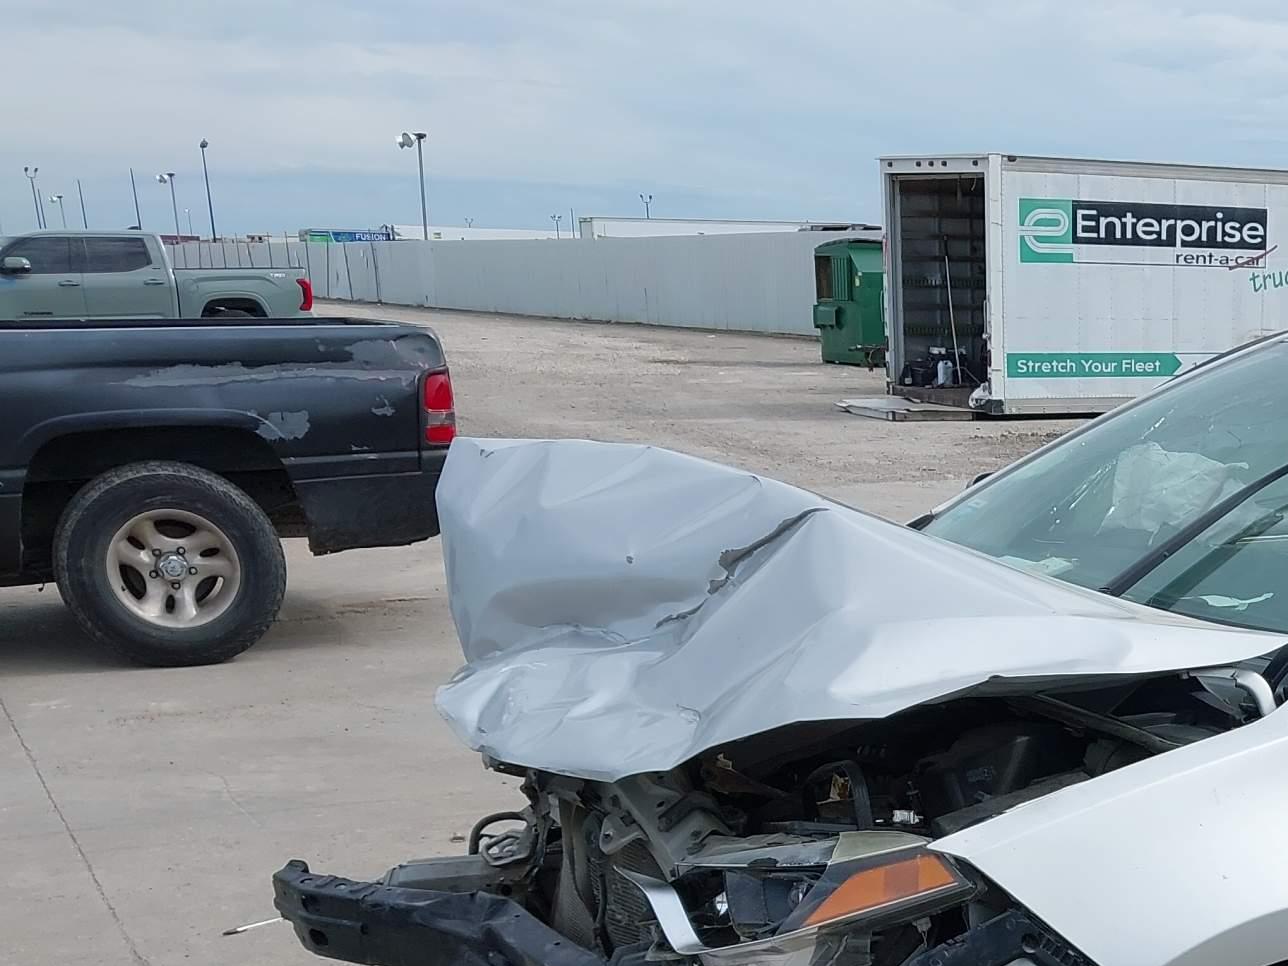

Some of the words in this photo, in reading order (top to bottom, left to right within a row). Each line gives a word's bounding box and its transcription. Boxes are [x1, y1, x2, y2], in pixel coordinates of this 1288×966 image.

[1076, 209, 1265, 249] Enterprise
[1175, 252, 1264, 267] rent-a-car
[1017, 359, 1076, 373] Stretch
[1081, 359, 1118, 373] Your
[1121, 359, 1161, 373] Fleet
